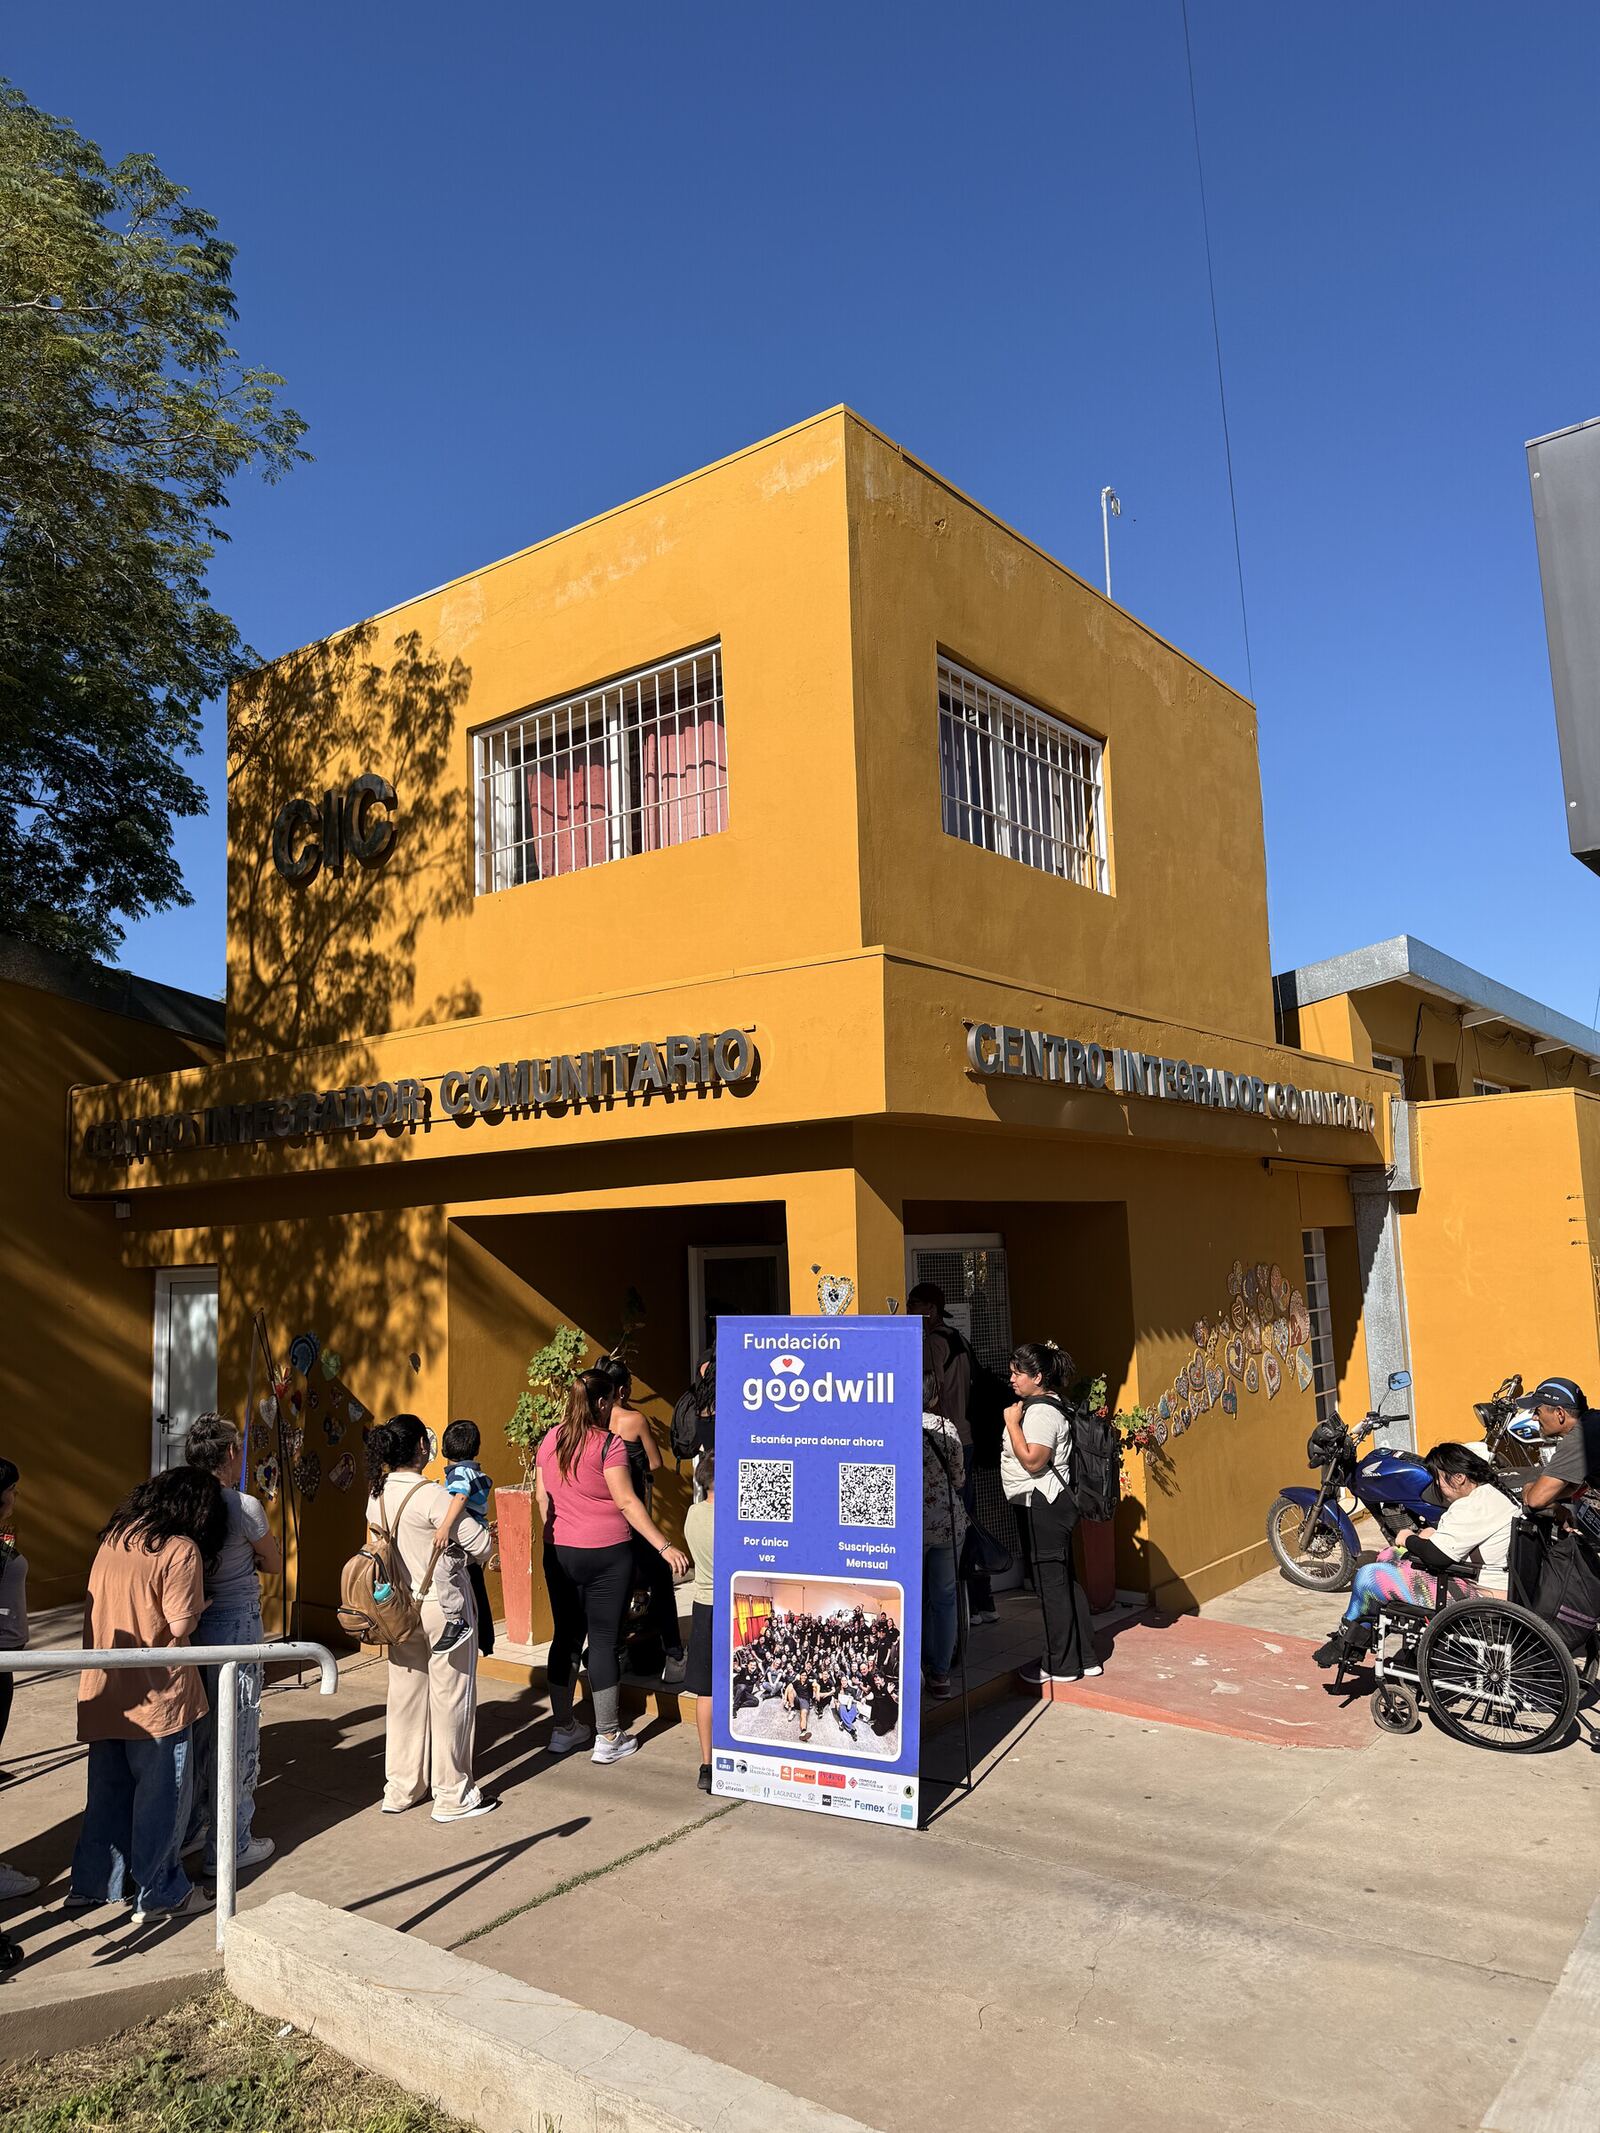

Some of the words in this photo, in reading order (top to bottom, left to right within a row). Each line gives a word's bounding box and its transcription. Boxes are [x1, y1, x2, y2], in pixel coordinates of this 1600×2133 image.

[273, 773, 398, 878] CIC
[967, 1023, 1106, 1088] CENTRO
[1113, 1047, 1265, 1114] INTEGRADOR
[1267, 1082, 1376, 1134] COMUNITARIO
[204, 1078, 425, 1145] INTEGRADOR
[440, 1028, 755, 1115] COMUNITARIO
[744, 1333, 841, 1350] Fundación
[742, 1371, 895, 1412] goodwill
[794, 1437, 819, 1447] para
[820, 1436, 851, 1447] donar
[852, 1438, 884, 1448] ahora
[743, 1536, 760, 1547] Por
[761, 1536, 789, 1548] única
[838, 1541, 896, 1555] Suscripción
[758, 1554, 776, 1563] vez
[846, 1558, 888, 1570] Mensual
[854, 1800, 885, 1813] Femex
